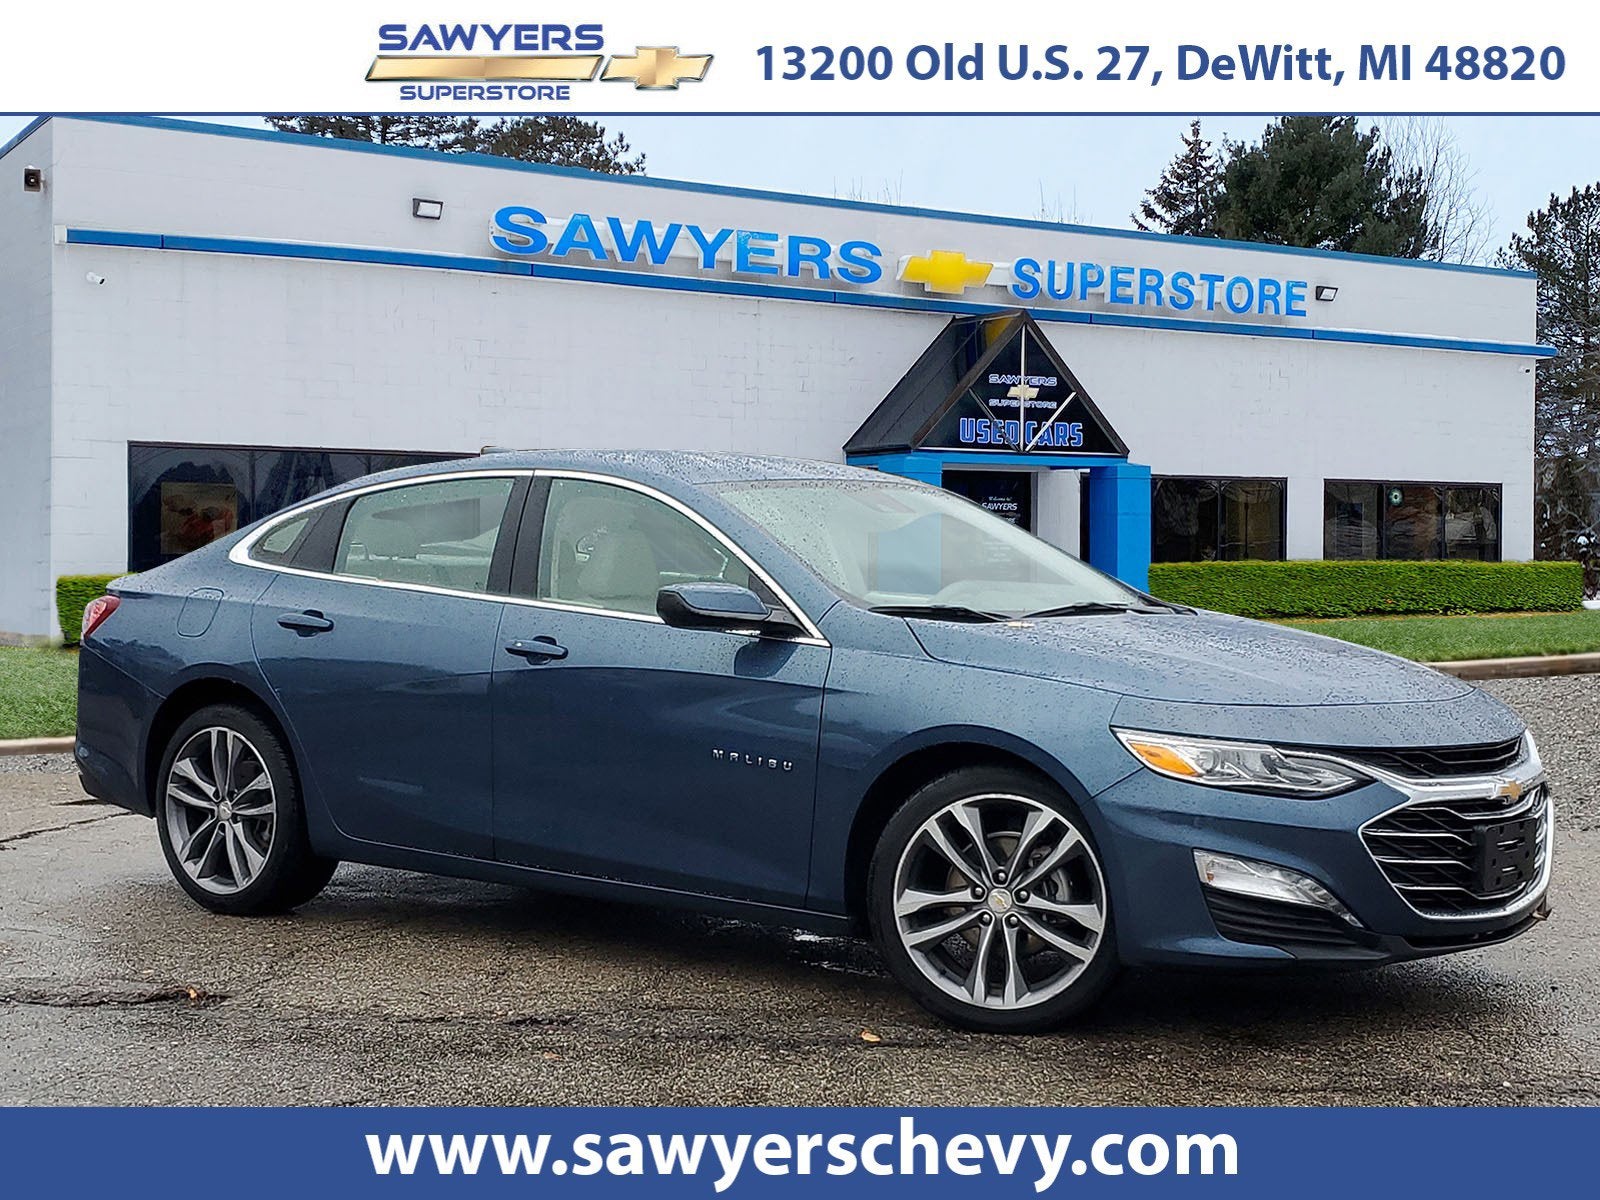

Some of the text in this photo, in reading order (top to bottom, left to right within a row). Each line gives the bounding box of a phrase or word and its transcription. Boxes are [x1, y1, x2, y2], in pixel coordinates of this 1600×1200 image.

[491, 205, 883, 285] SAWYERS
[1011, 257, 1308, 318] SUPERSTORE
[988, 374, 1057, 387] SAWYERS
[959, 417, 1084, 447] USED CARS
[981, 502, 1018, 511] SAWYERS
[712, 748, 793, 771] MALIBU
